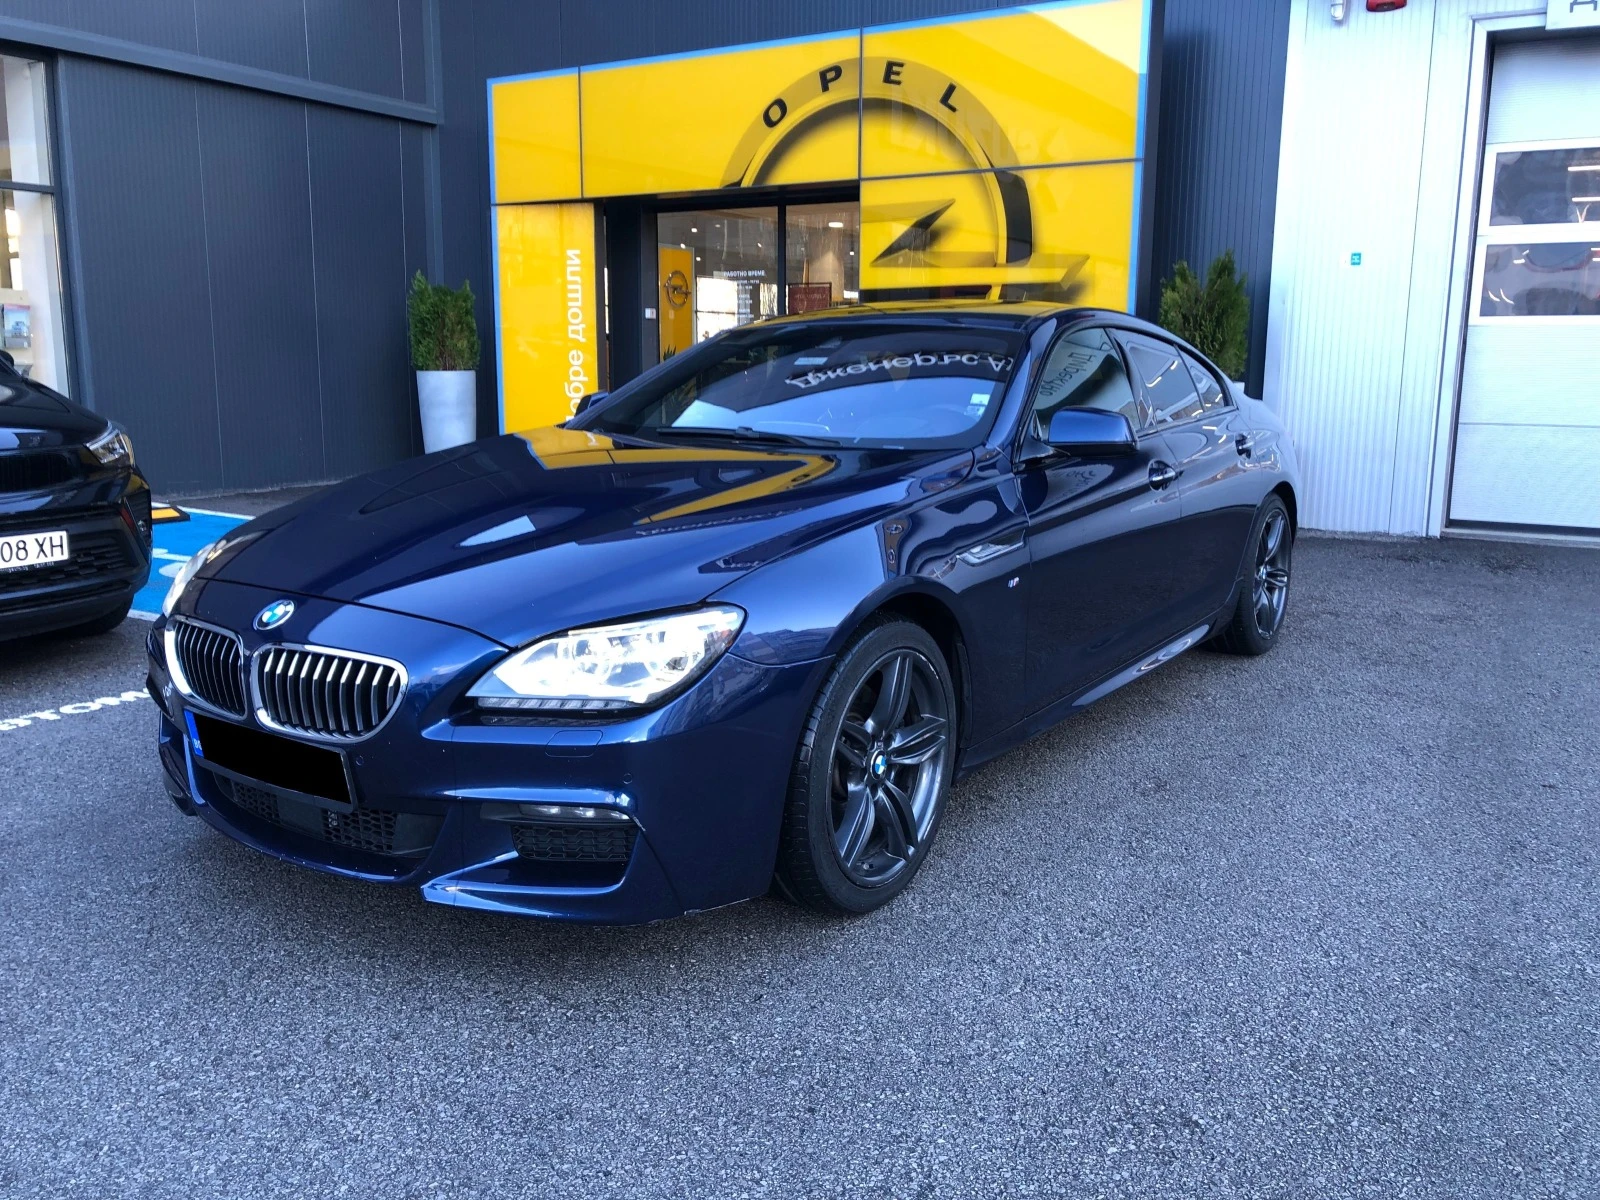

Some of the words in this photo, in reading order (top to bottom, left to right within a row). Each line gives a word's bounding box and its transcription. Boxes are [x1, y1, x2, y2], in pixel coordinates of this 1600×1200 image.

[762, 60, 958, 128] OPEL
[566, 249, 586, 343] дошли
[564, 349, 589, 421] обре
[35, 535, 64, 559] XH
